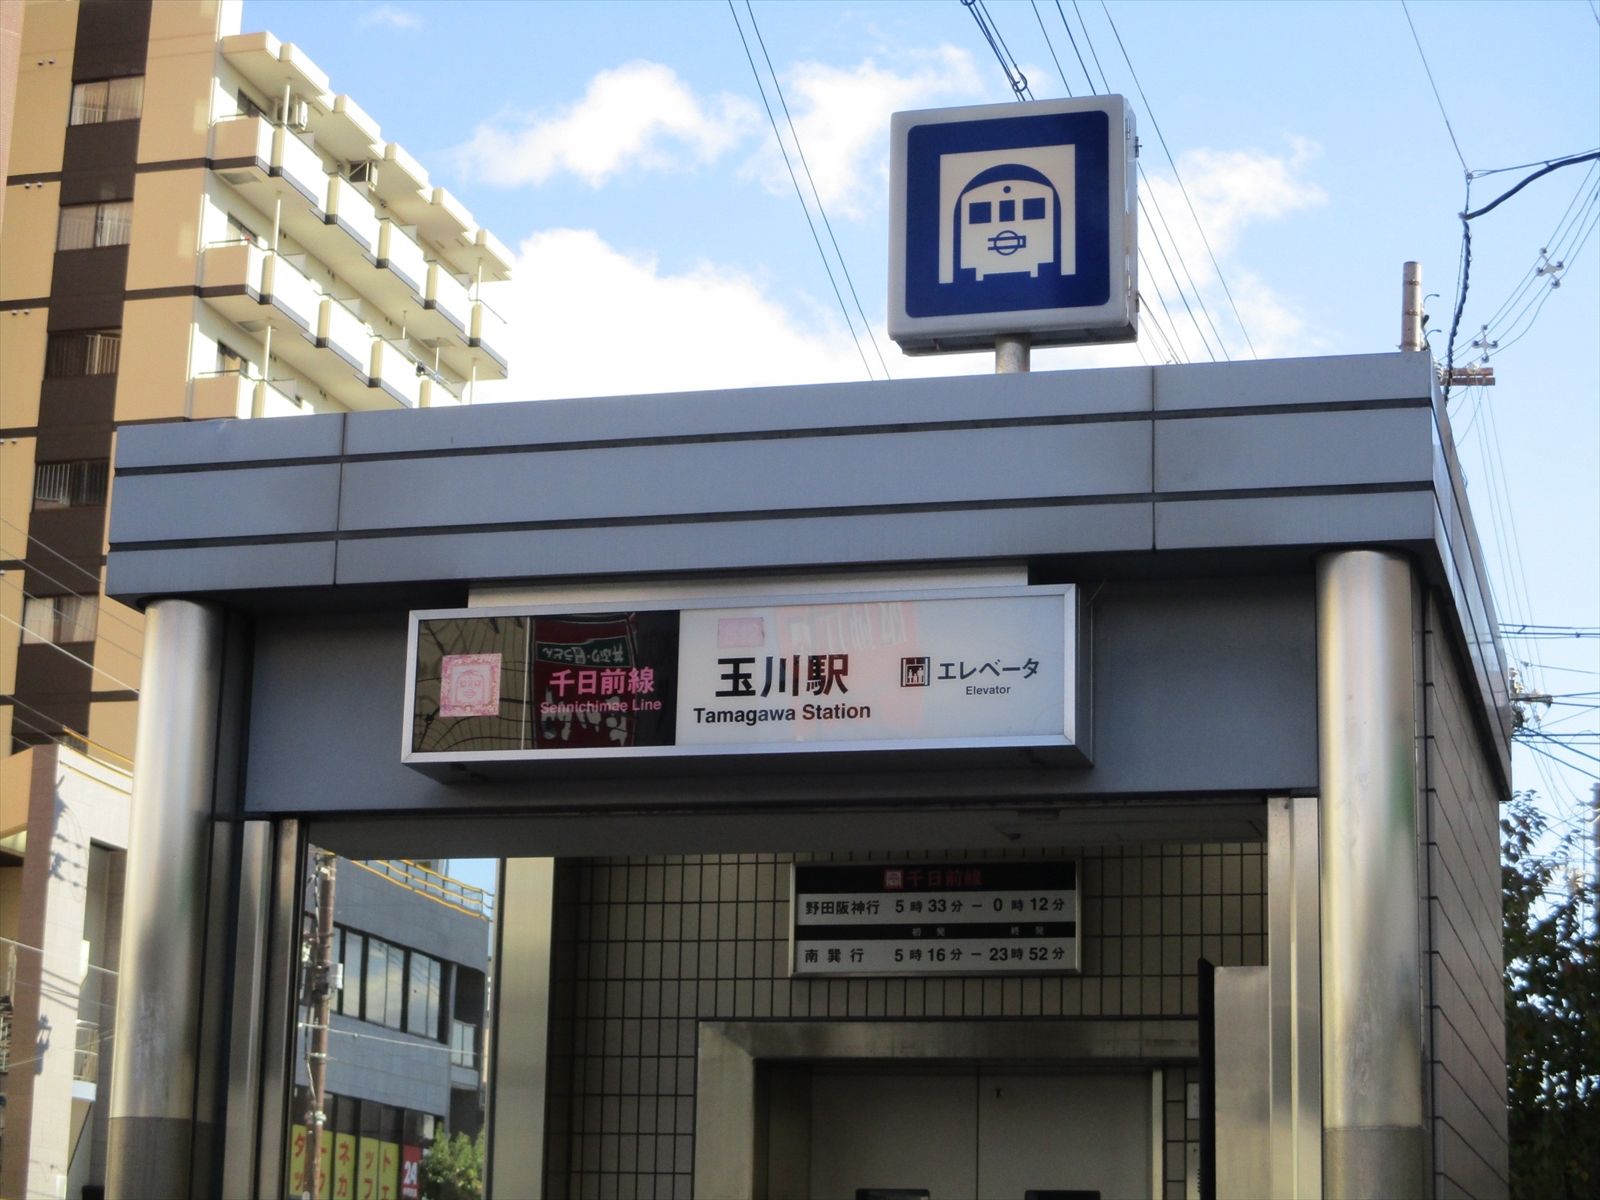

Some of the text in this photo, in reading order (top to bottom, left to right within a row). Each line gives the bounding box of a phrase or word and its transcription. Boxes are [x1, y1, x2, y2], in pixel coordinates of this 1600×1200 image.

[715, 654, 849, 698] 玉川駅
[937, 658, 1040, 681] エレベータ
[549, 667, 656, 697] 千日前線
[966, 684, 1011, 696] Elevator
[540, 697, 662, 715] Sennichimae Line
[693, 702, 871, 727] Tamagawa Station
